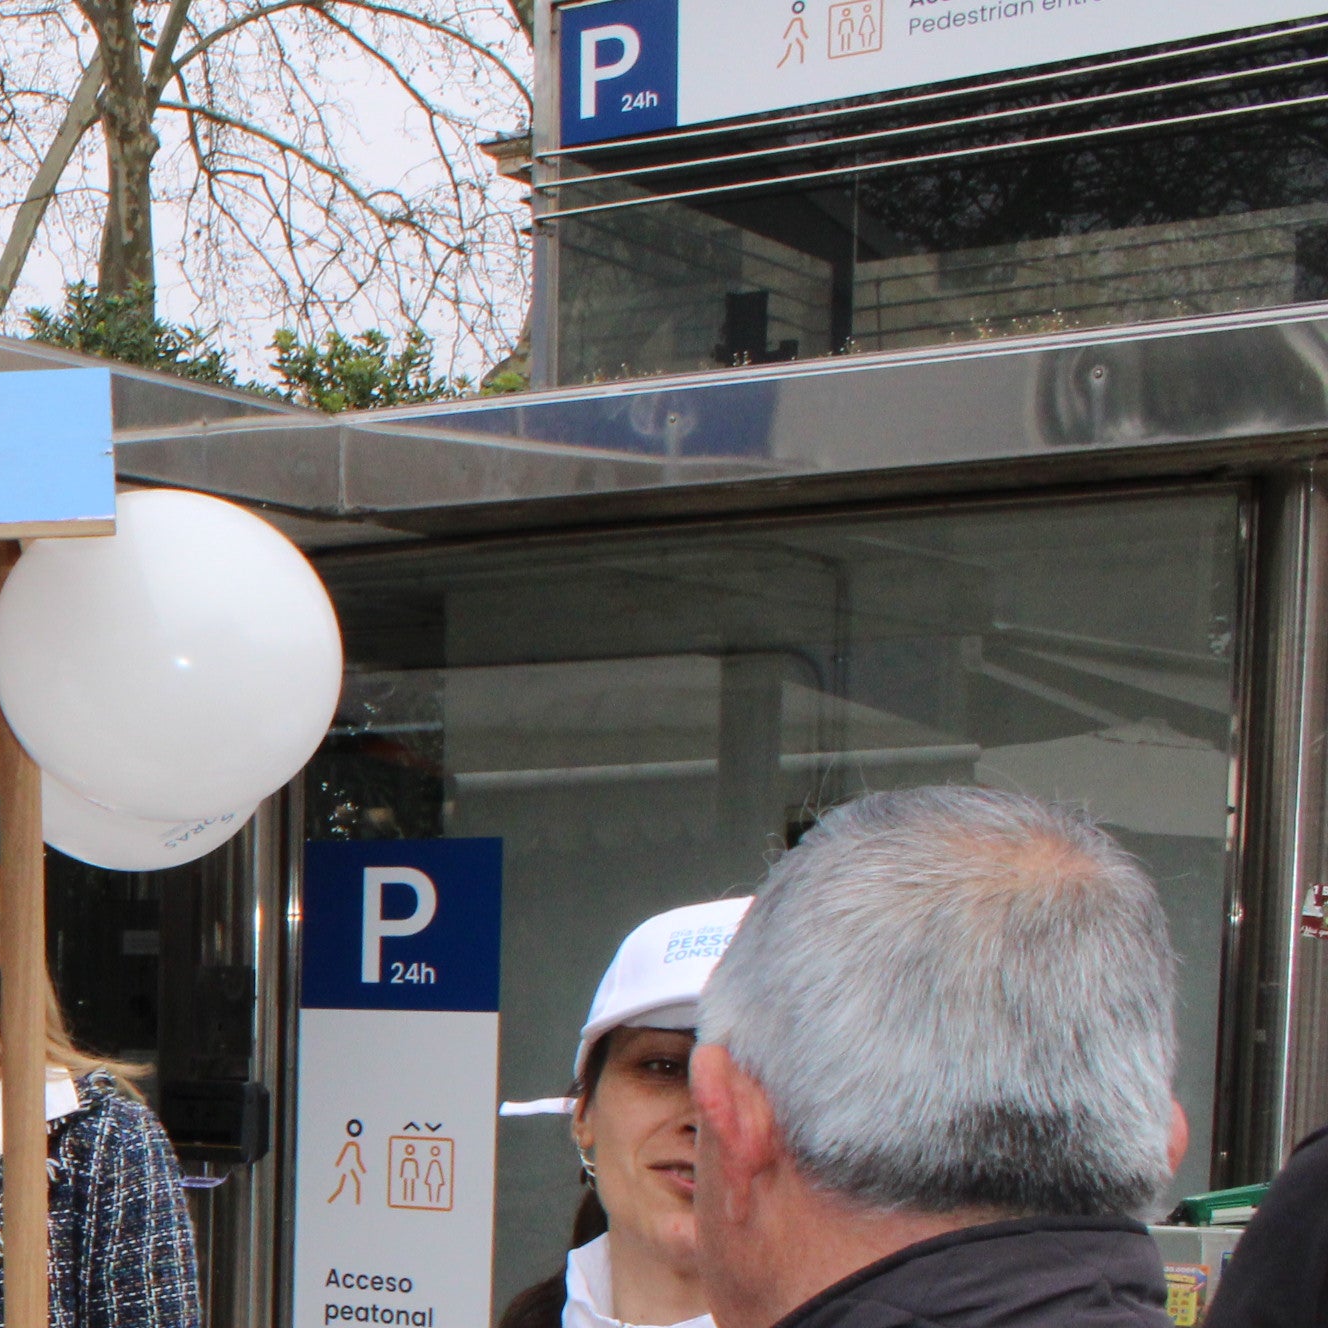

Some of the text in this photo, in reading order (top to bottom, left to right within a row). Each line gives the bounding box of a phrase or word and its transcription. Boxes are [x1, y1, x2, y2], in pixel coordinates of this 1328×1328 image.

[908, 0, 1035, 36] Pedestrian
[580, 23, 641, 120] P
[621, 91, 658, 113] 24h
[361, 866, 438, 983] P
[390, 961, 436, 984] 24h
[325, 1268, 414, 1294] Acceso
[324, 1303, 434, 1328] peatonal
